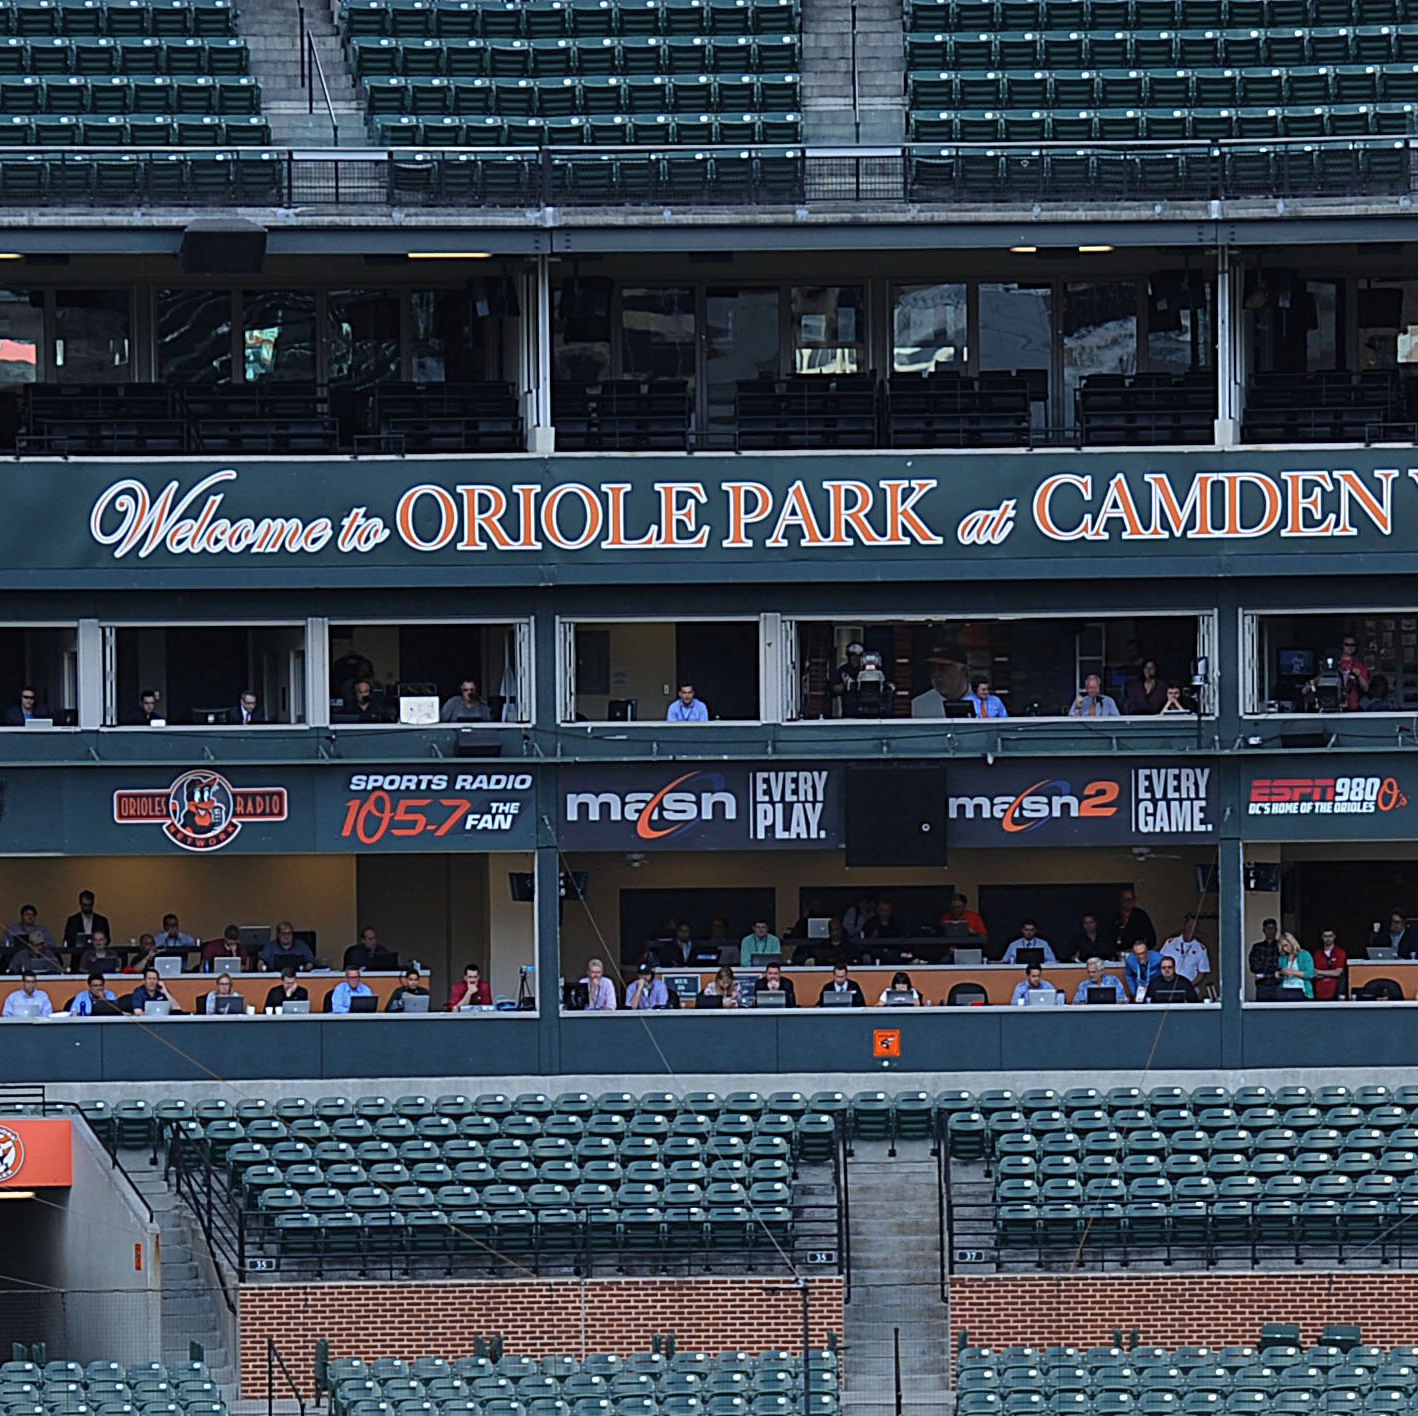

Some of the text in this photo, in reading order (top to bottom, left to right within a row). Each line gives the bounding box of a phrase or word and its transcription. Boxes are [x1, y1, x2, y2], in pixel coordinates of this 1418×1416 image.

[90, 469, 333, 558] Welcome
[337, 507, 390, 553] to
[395, 482, 710, 552] ORIOLE
[722, 480, 943, 548] PARK
[957, 499, 1017, 546] at
[1033, 468, 1400, 541] CAMDEN
[349, 774, 533, 790] SPORTS RADIO
[755, 770, 829, 802] EVERY
[1138, 768, 1210, 799] EVERY
[1250, 779, 1334, 802] ESPN
[1335, 778, 1381, 802] 980
[121, 795, 280, 816] ORIOLES RADIO
[490, 802, 521, 814] THE
[566, 791, 737, 822] masn
[1138, 800, 1213, 833] GAME.
[1248, 802, 1375, 814] DC'S HOME OF THE ORIOLES
[464, 814, 513, 830] FAN
[755, 802, 826, 839] PLAY.
[167, 824, 236, 848] NETWORK
